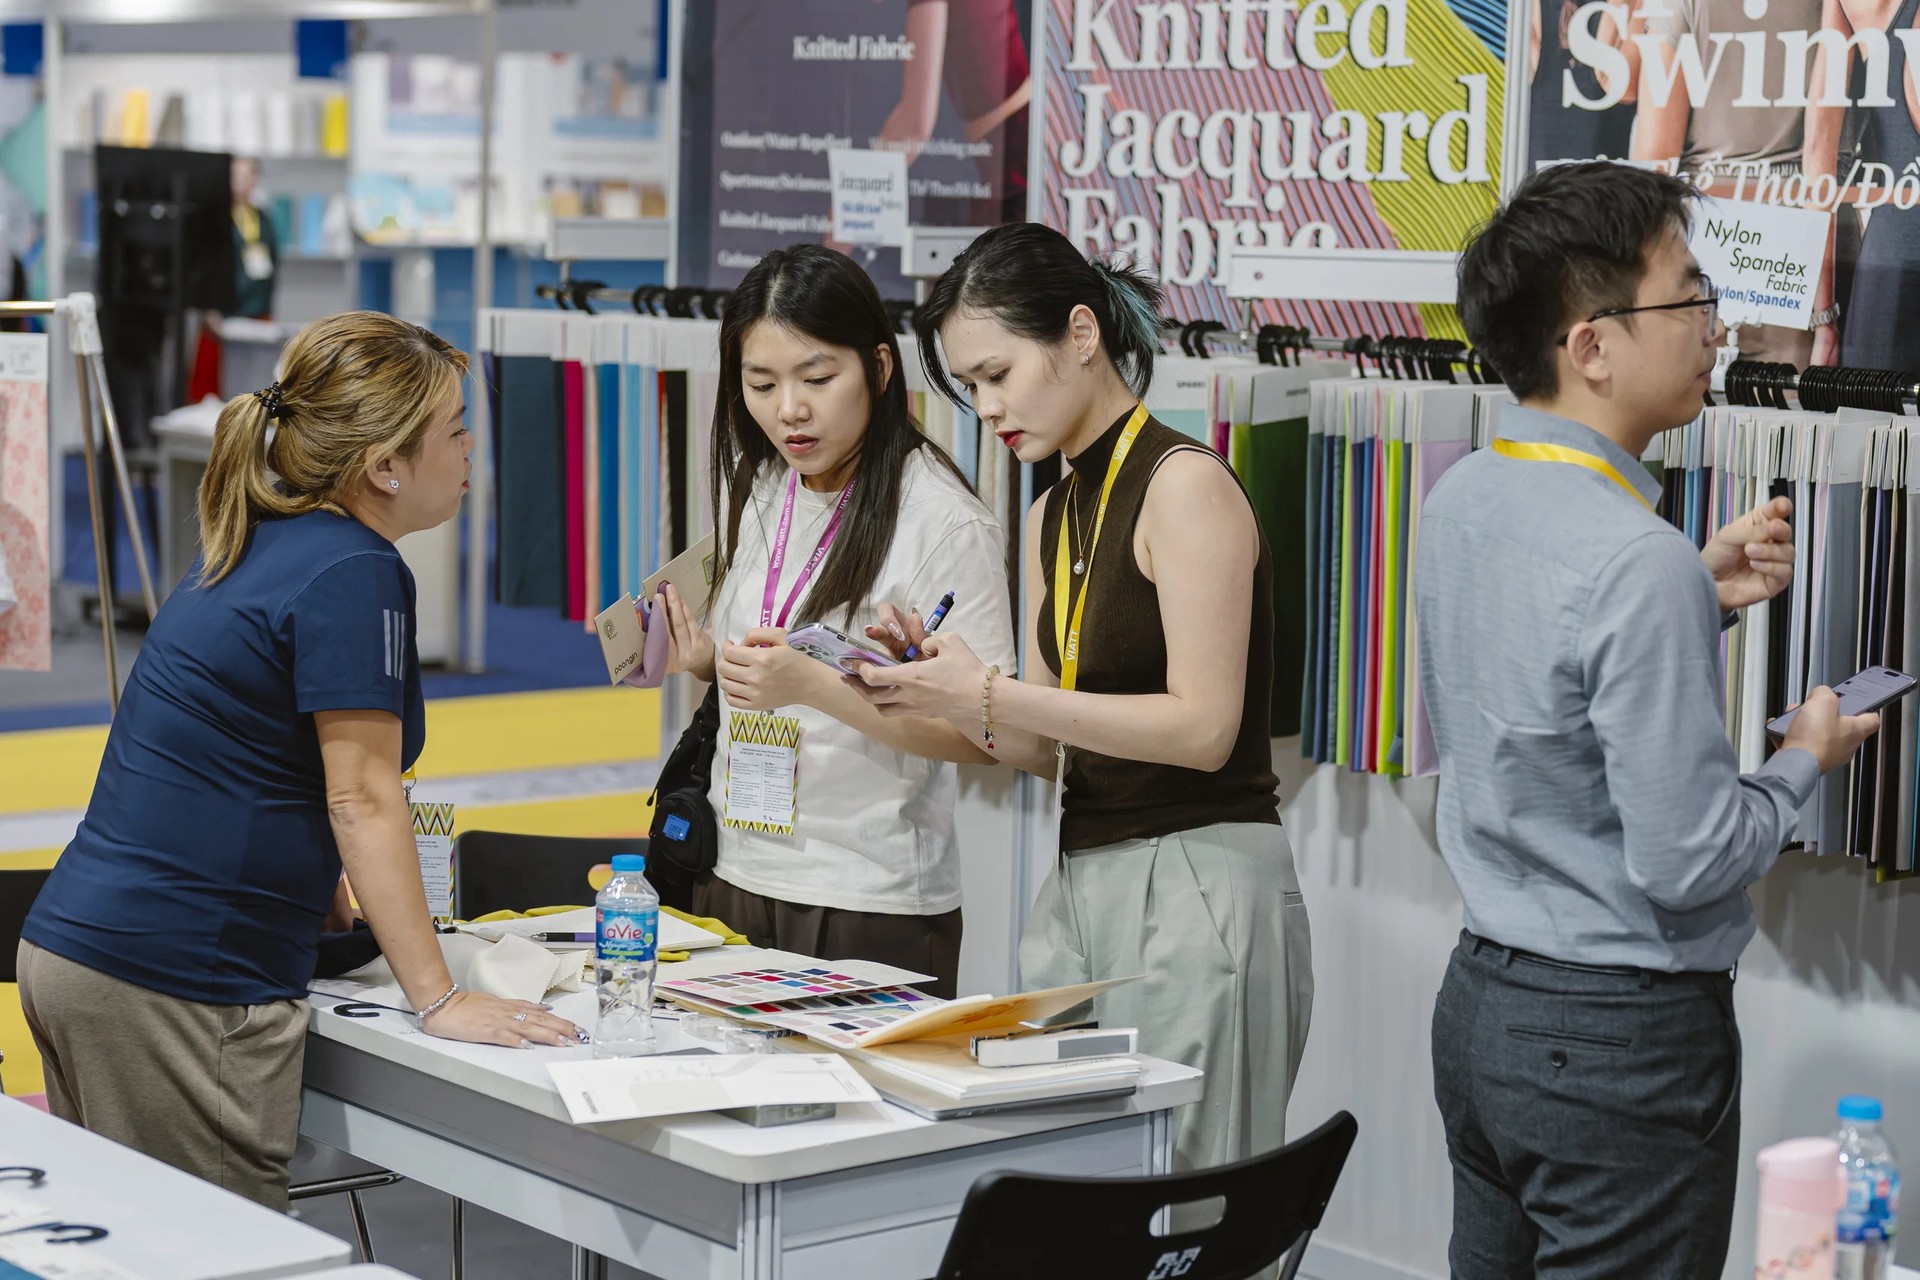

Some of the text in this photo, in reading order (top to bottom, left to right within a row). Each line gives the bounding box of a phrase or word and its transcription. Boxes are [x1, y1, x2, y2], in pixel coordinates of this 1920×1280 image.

[793, 34, 915, 60] Knitted Fabric
[1064, 0, 1414, 72] Knitted
[1059, 72, 1492, 208] Jacquard
[1704, 218, 1762, 247] Nylon
[1729, 247, 1807, 277] Spandex
[1765, 274, 1808, 295] Fabric
[1066, 629, 1079, 661] VIATT
[603, 923, 643, 940] laVie
